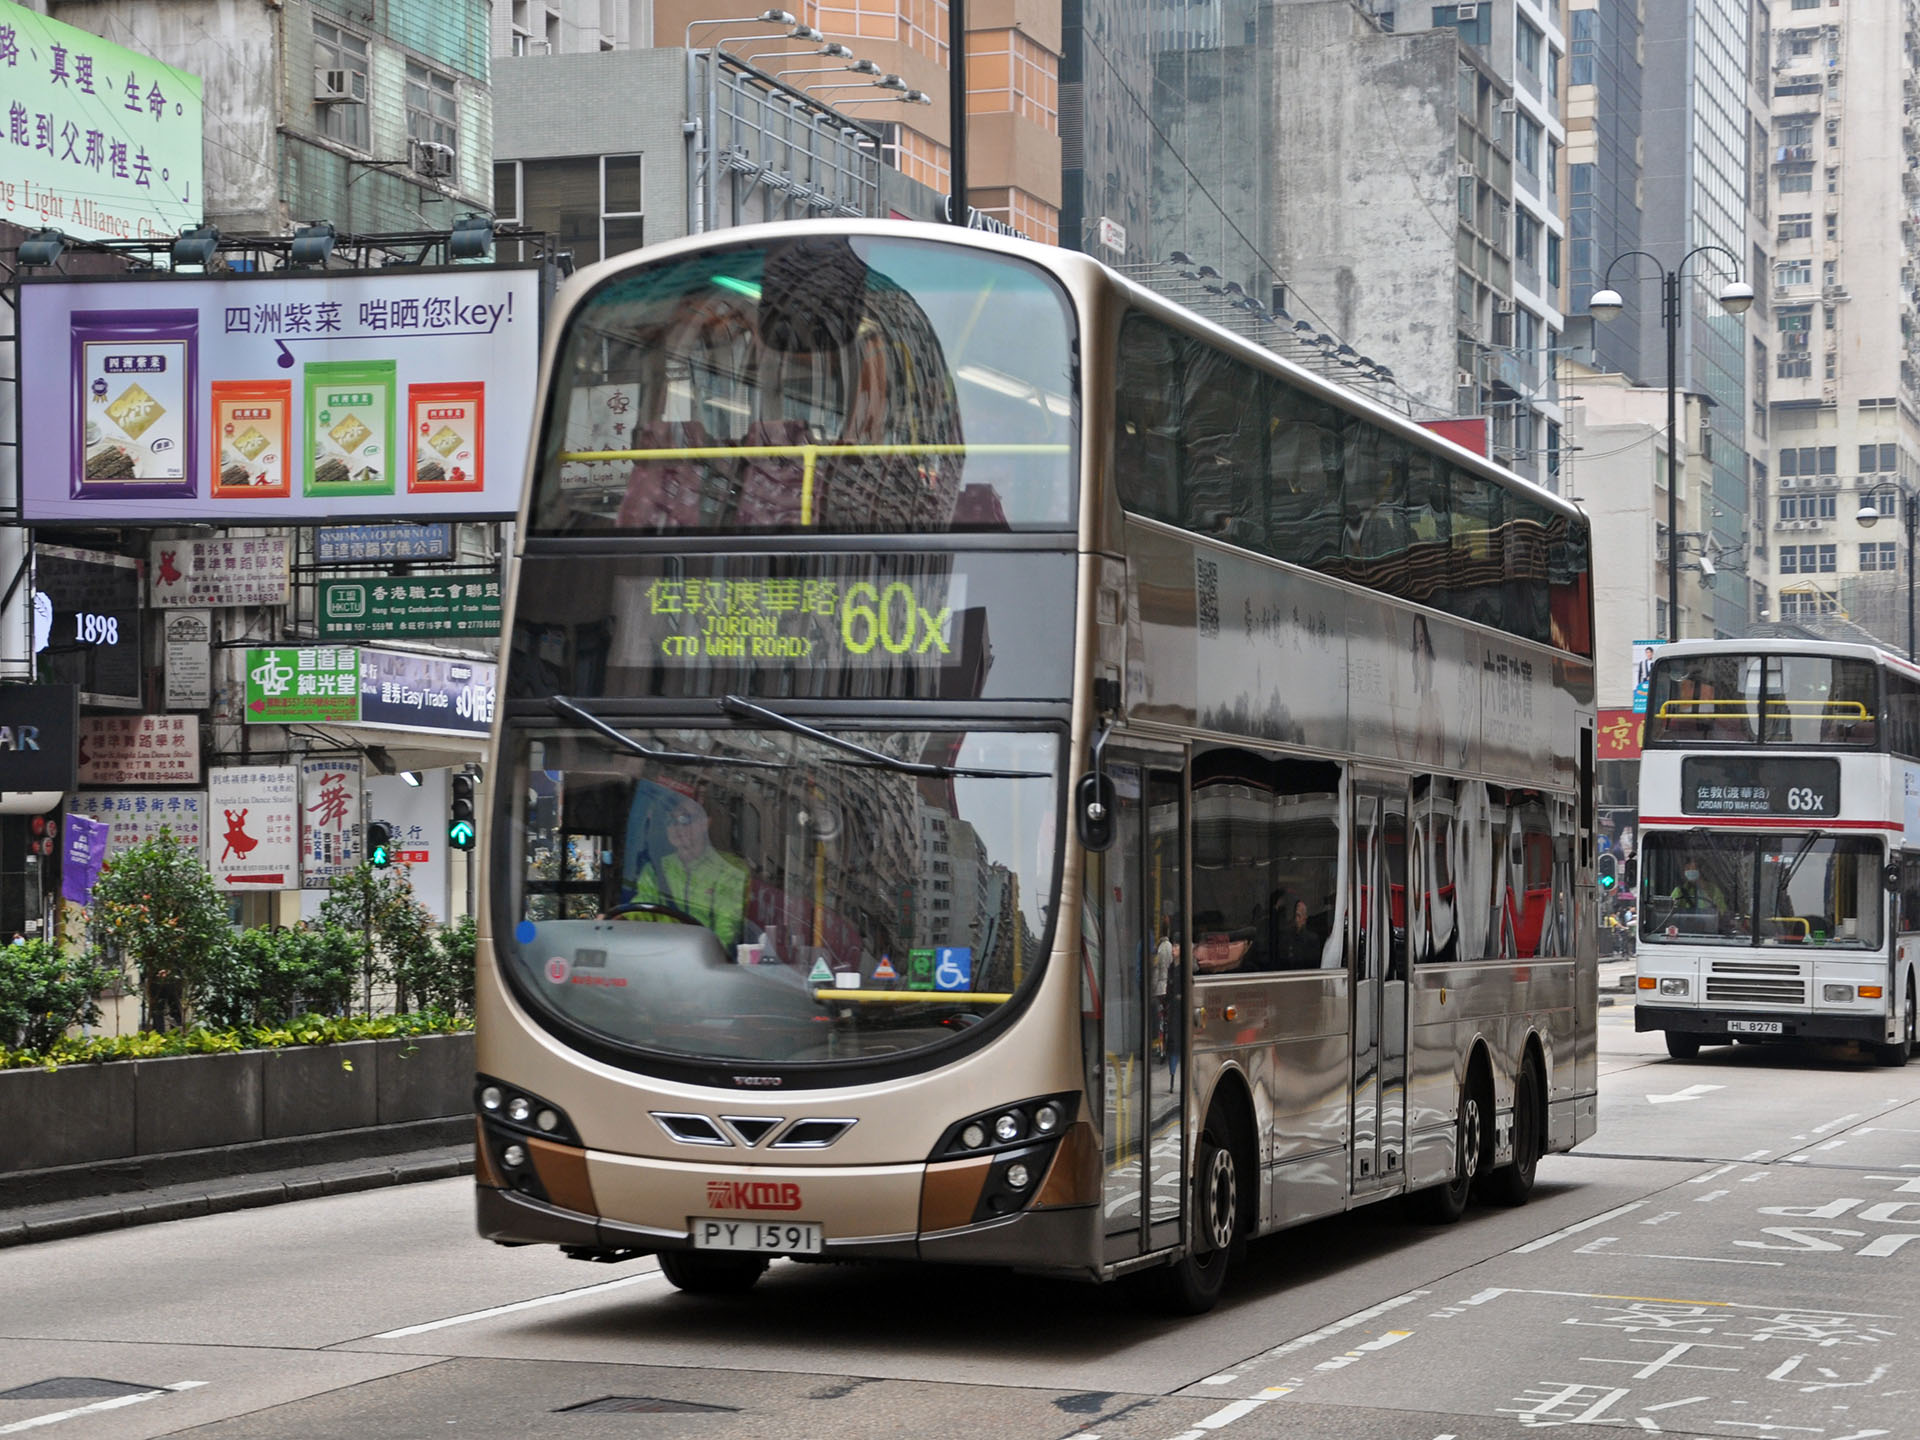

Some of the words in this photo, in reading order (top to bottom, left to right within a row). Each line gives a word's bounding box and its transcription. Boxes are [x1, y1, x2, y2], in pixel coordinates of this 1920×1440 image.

[0, 100, 190, 204] 能到父那裡去。」
[0, 180, 15, 212] ng
[24, 179, 64, 223] Light
[71, 196, 130, 239] Alliance
[223, 302, 343, 335] 四洲紫菜
[336, 590, 357, 602] 工盟
[372, 582, 501, 601] 香港職工會聯盟
[331, 602, 361, 613] HKCTU
[841, 582, 951, 653] 60x
[75, 612, 118, 645] 1898
[702, 615, 778, 636] JORDAN
[661, 636, 699, 656] (TO
[704, 637, 746, 656] WAH
[751, 637, 813, 656] ROAD)
[297, 648, 356, 671] 宣道會
[297, 674, 356, 696] 純光堂
[1697, 786, 1771, 800] 佐敦(渡華路)
[1786, 787, 1824, 812] 63x
[70, 796, 199, 813] 香港舞蹈藝術學院
[1696, 800, 1723, 810] JORDAN
[1735, 801, 1749, 810] WAH
[1731, 1021, 1746, 1031] HL
[1749, 1022, 1779, 1032] 8278
[733, 1076, 783, 1086] VOLVO
[733, 1182, 803, 1212] KMB
[705, 1223, 740, 1247] PY
[756, 1224, 813, 1250] 1591
